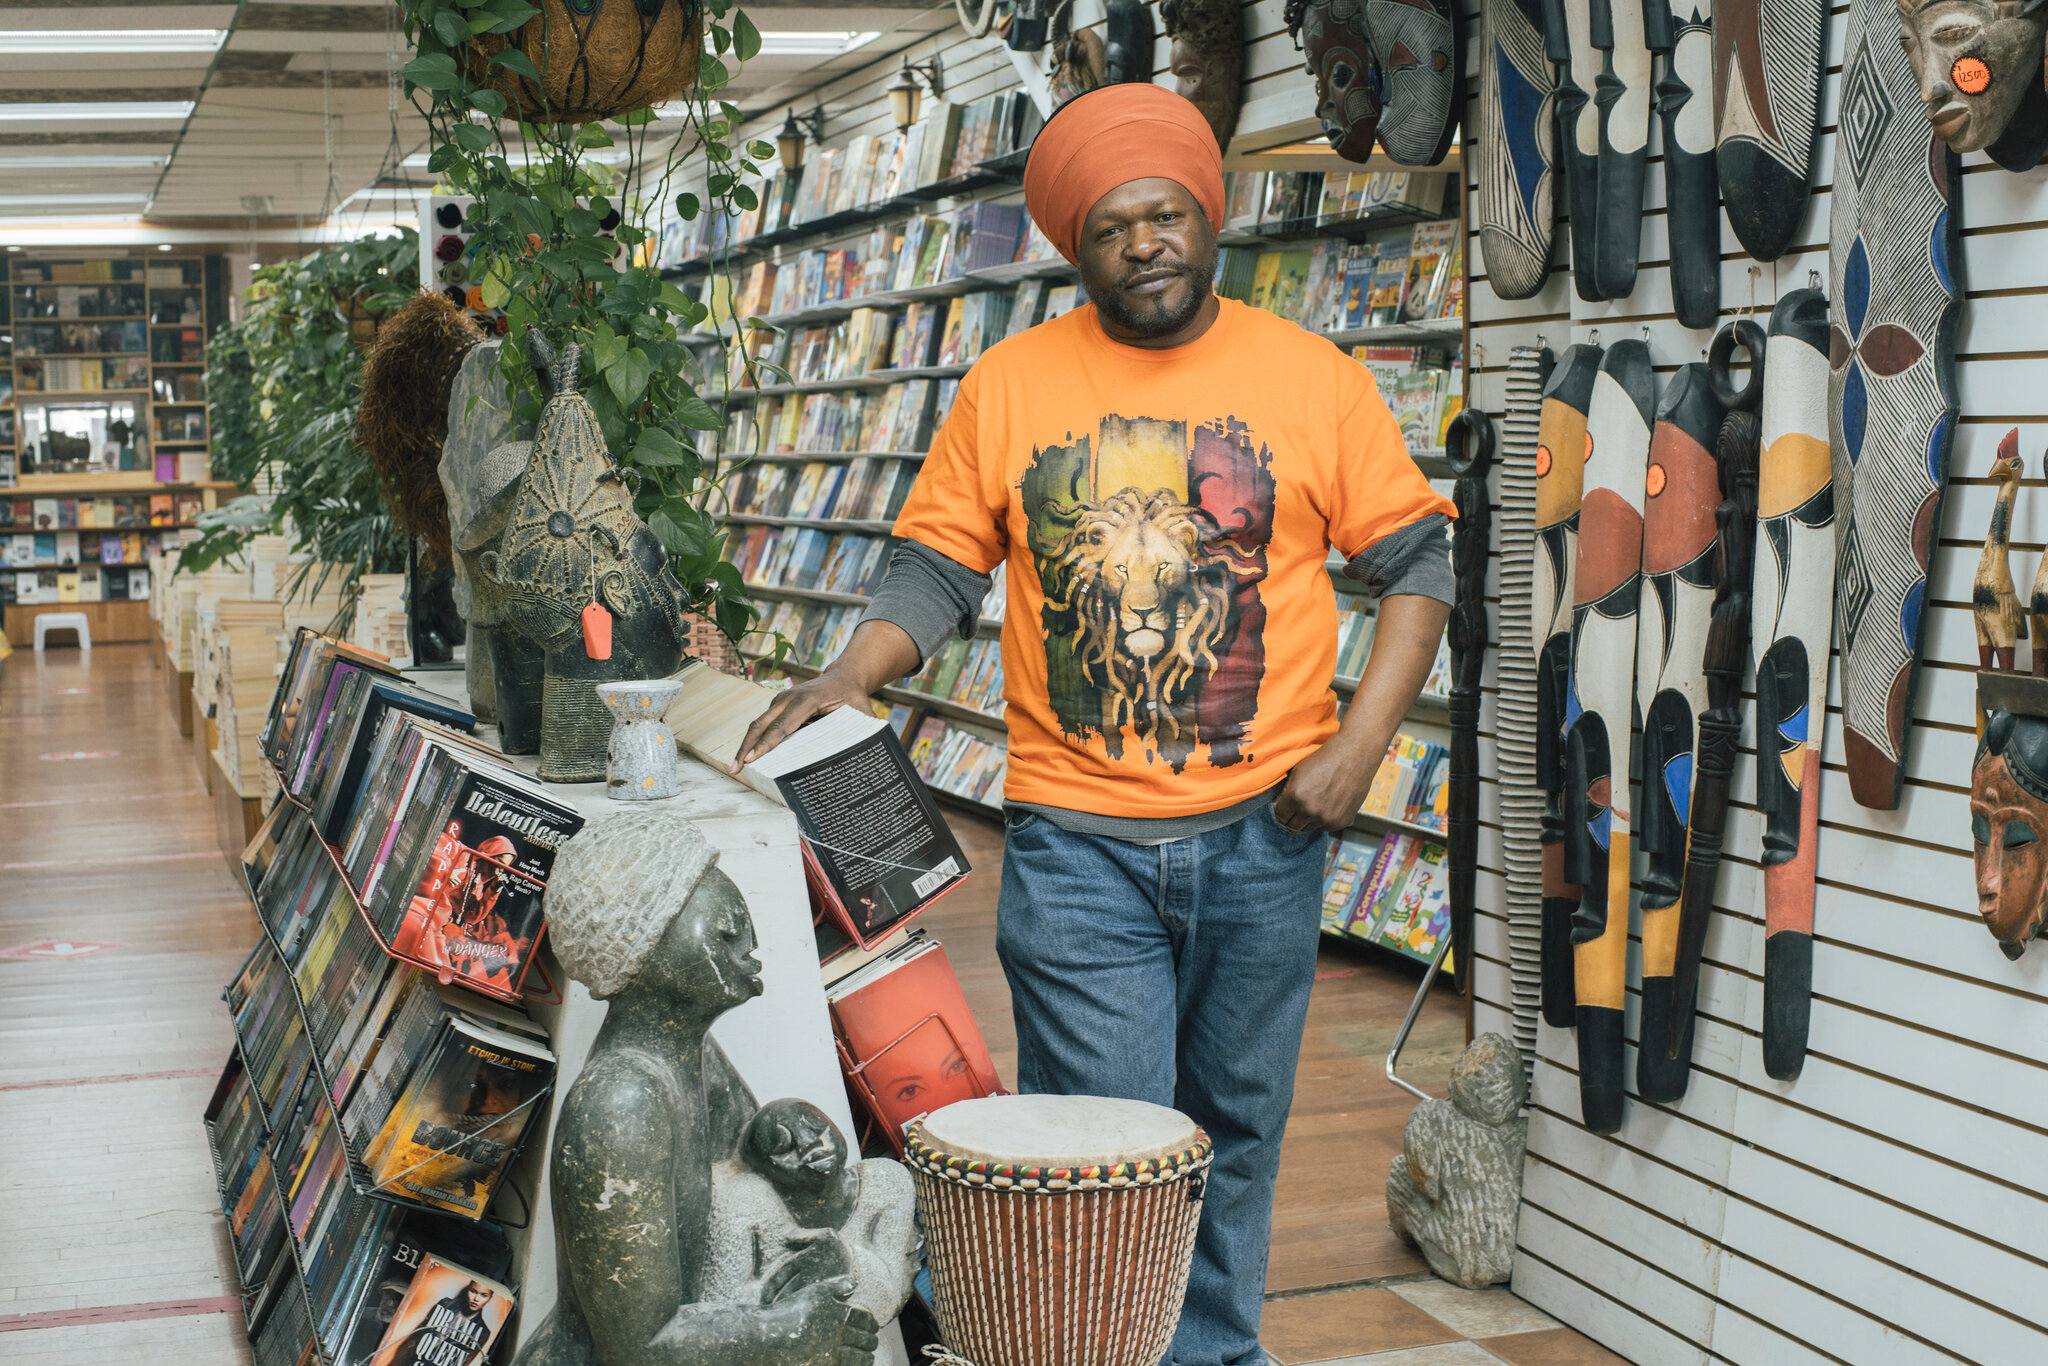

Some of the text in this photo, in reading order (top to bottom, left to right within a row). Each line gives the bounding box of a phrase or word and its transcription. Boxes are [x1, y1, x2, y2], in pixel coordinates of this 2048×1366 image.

[508, 874, 543, 893] Rap Career
[519, 861, 546, 877] How Much
[1355, 842, 1394, 918] Computing
[454, 941, 509, 959] DANGER
[411, 1119, 506, 1168] BOUNCE
[426, 1303, 484, 1351] DRAMA
[415, 1332, 471, 1366] QUEEN
